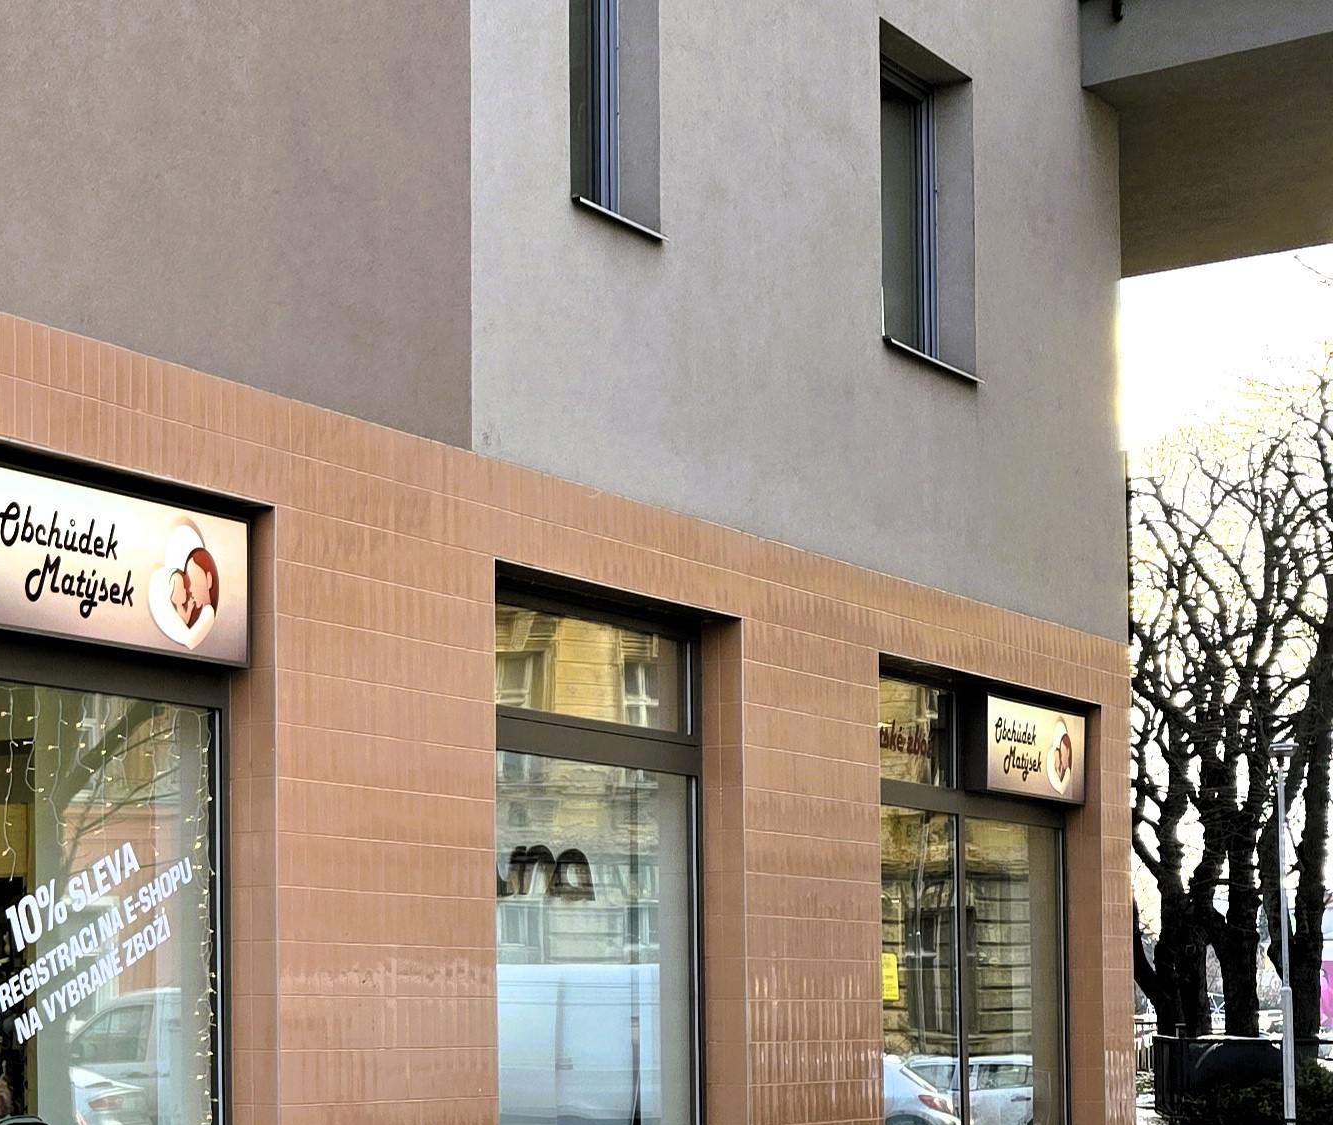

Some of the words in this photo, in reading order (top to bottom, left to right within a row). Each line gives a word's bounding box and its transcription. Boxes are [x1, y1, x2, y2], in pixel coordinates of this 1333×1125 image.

[0, 501, 118, 560] Obchůdek
[24, 553, 134, 618] Matýsek
[995, 717, 1036, 746] Obchůdek
[1003, 747, 1042, 781] Matýsek
[5, 879, 68, 952] 10%
[68, 842, 140, 913] SLEVA
[97, 905, 125, 942] NA
[123, 857, 193, 924] E-SHOPU
[13, 1006, 44, 1045] NA
[42, 944, 123, 1023] VYBRANÉ
[122, 907, 171, 967] ZBOŽÍ
